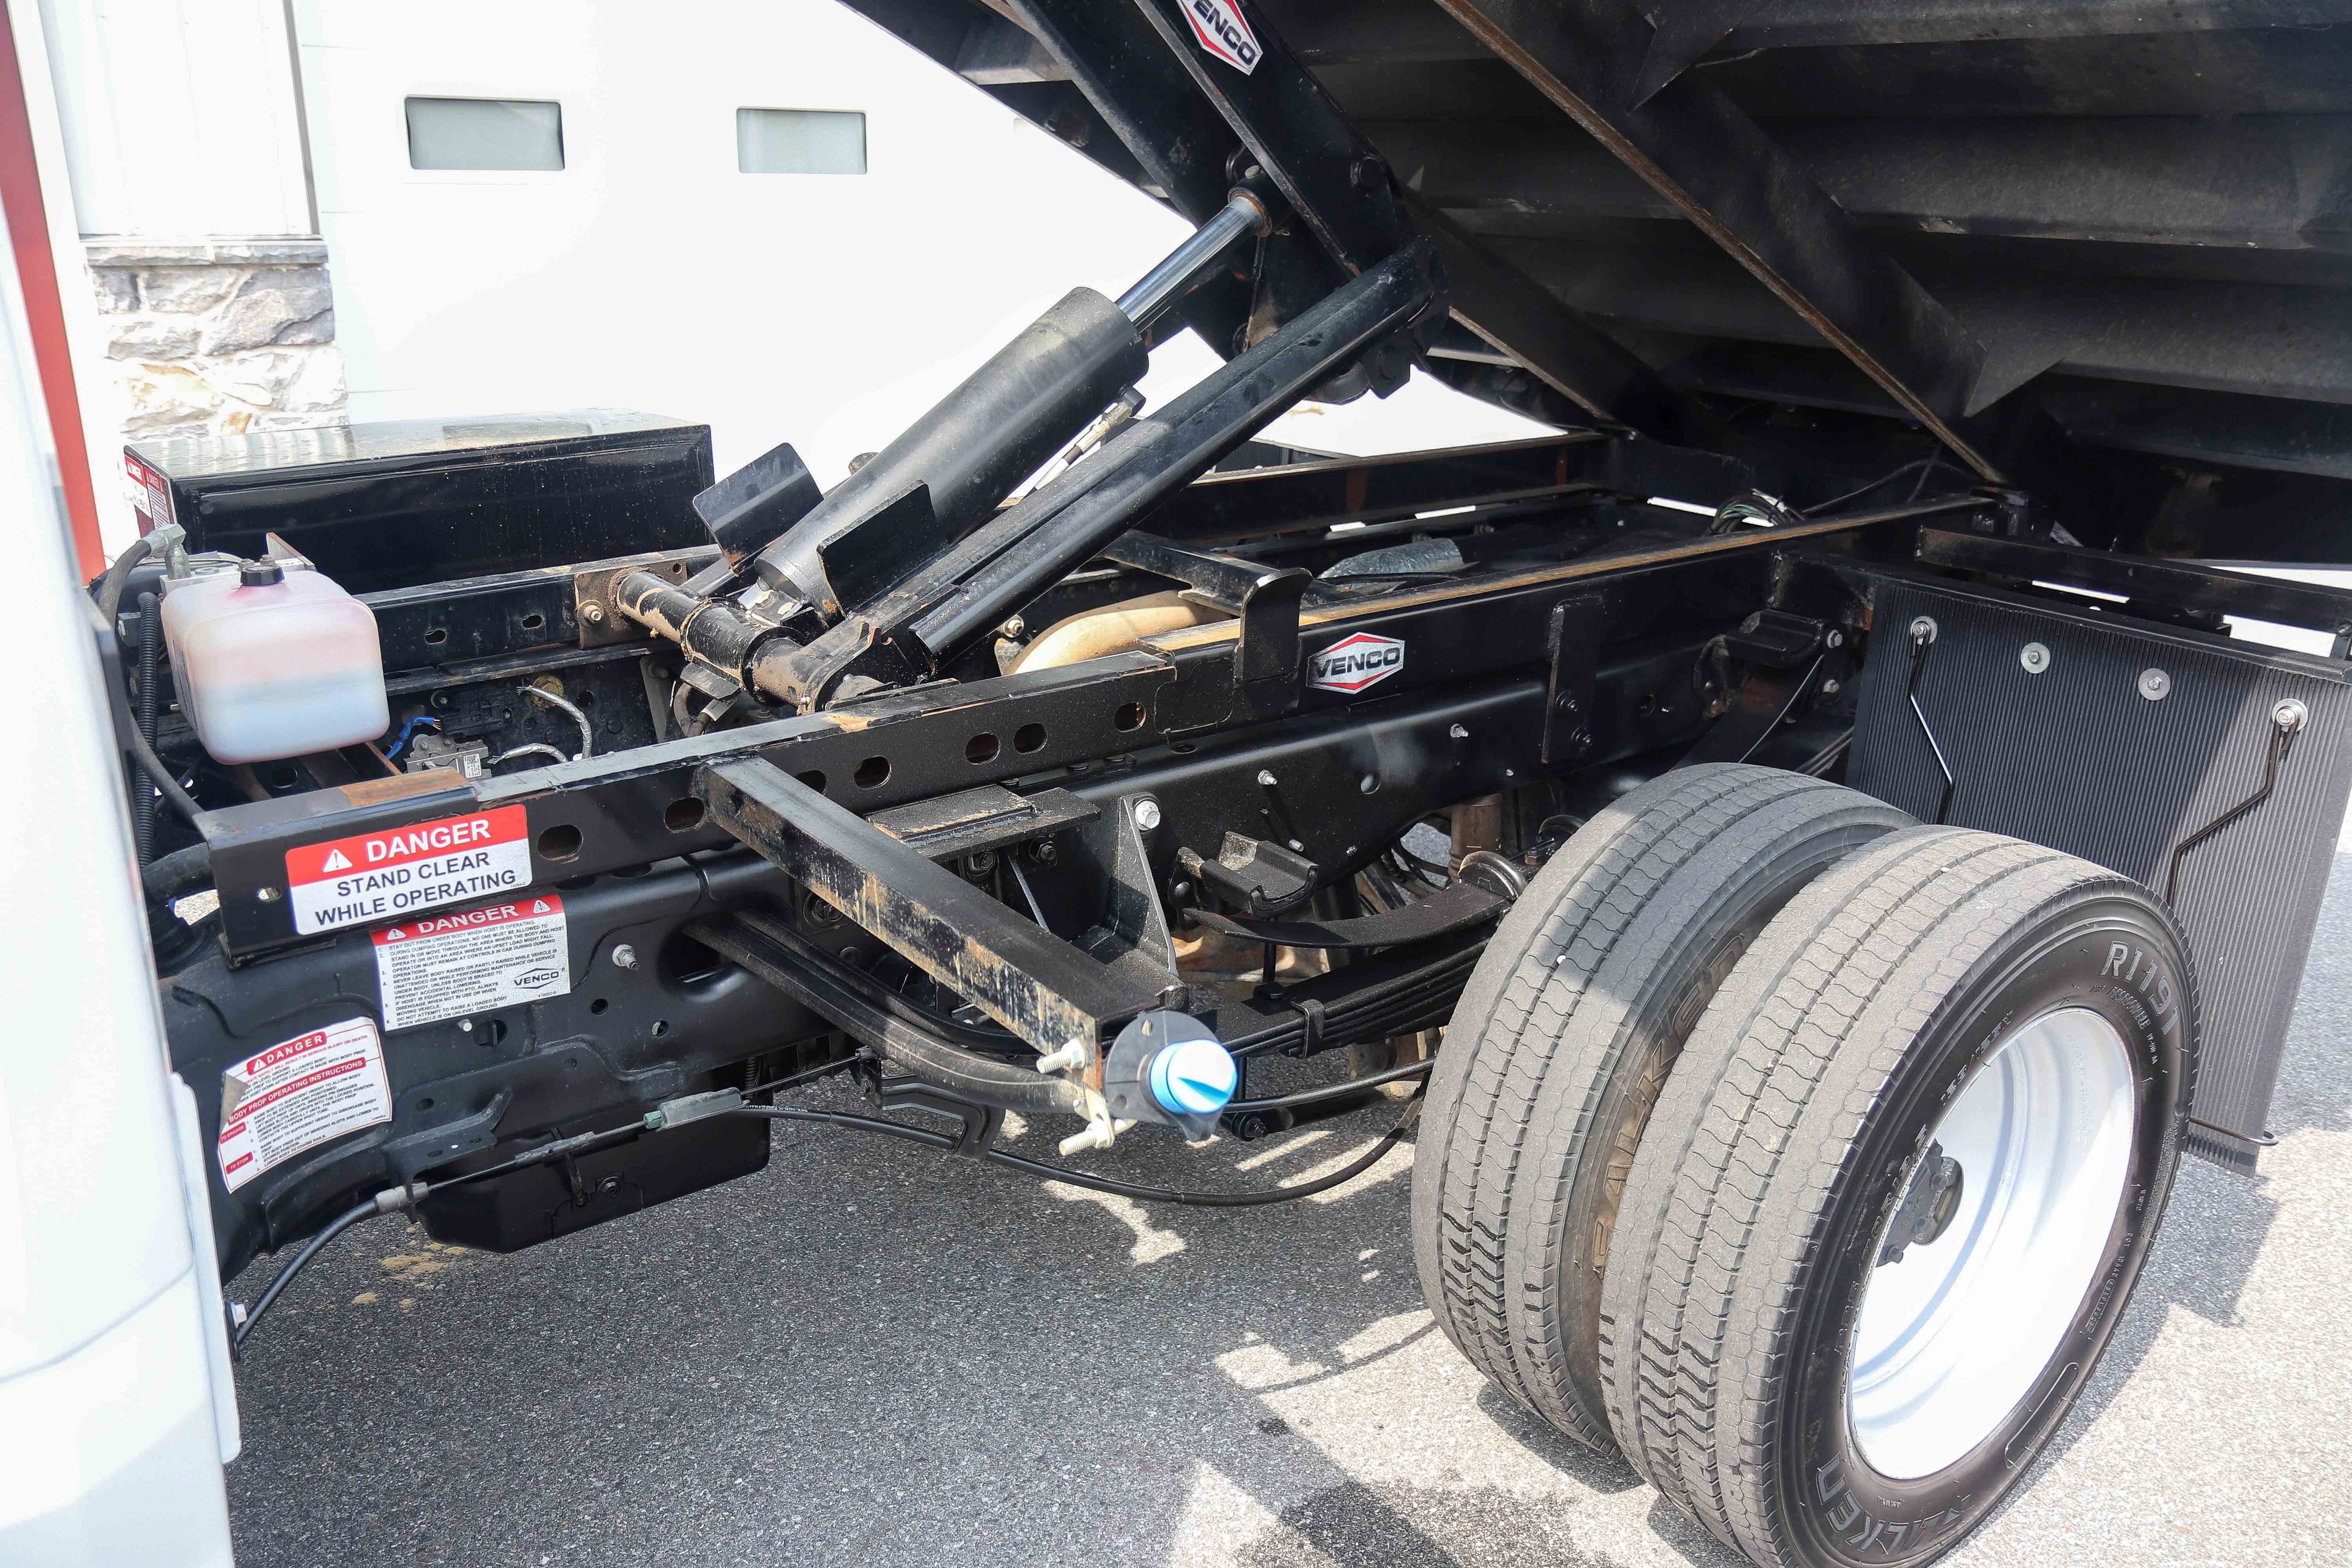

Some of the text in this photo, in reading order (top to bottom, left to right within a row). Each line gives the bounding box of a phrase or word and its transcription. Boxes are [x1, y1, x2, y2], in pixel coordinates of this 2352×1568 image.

[1187, 0, 1256, 66] ENCO
[1313, 648, 1400, 678] VENCO
[367, 819, 492, 862] DANGER
[337, 852, 490, 897] STAND CLEAR
[315, 870, 516, 926] WHILE OPERATING
[417, 905, 519, 933] DANGER
[506, 920, 535, 929] OPERATING.
[411, 944, 435, 952] DUMPING
[516, 925, 540, 933] ALLOWED
[442, 944, 467, 952] THROUGH
[392, 964, 421, 973] OPERATOR
[467, 950, 494, 959] CONTROLS
[533, 938, 555, 946] DUMPING
[392, 959, 416, 967] OPERATE
[394, 979, 428, 989] UNATTENDED
[456, 967, 489, 977] PERFORMING
[490, 960, 526, 971] MAINTENANCE
[513, 971, 559, 986] VENCO
[394, 992, 419, 1000] PREVENT
[419, 985, 452, 996] ACCIDENTAL
[396, 1001, 426, 1011] DISENGAGE
[424, 991, 450, 1000] EQUIPPED
[414, 1015, 436, 1023] VEHICLE
[452, 1007, 474, 1016] UNLEVEL
[417, 1009, 441, 1018] ATTEMPT
[267, 1035, 323, 1064] DANGER
[229, 1060, 363, 1123] BODY PROP OPERATING INSTRUCTIONS
